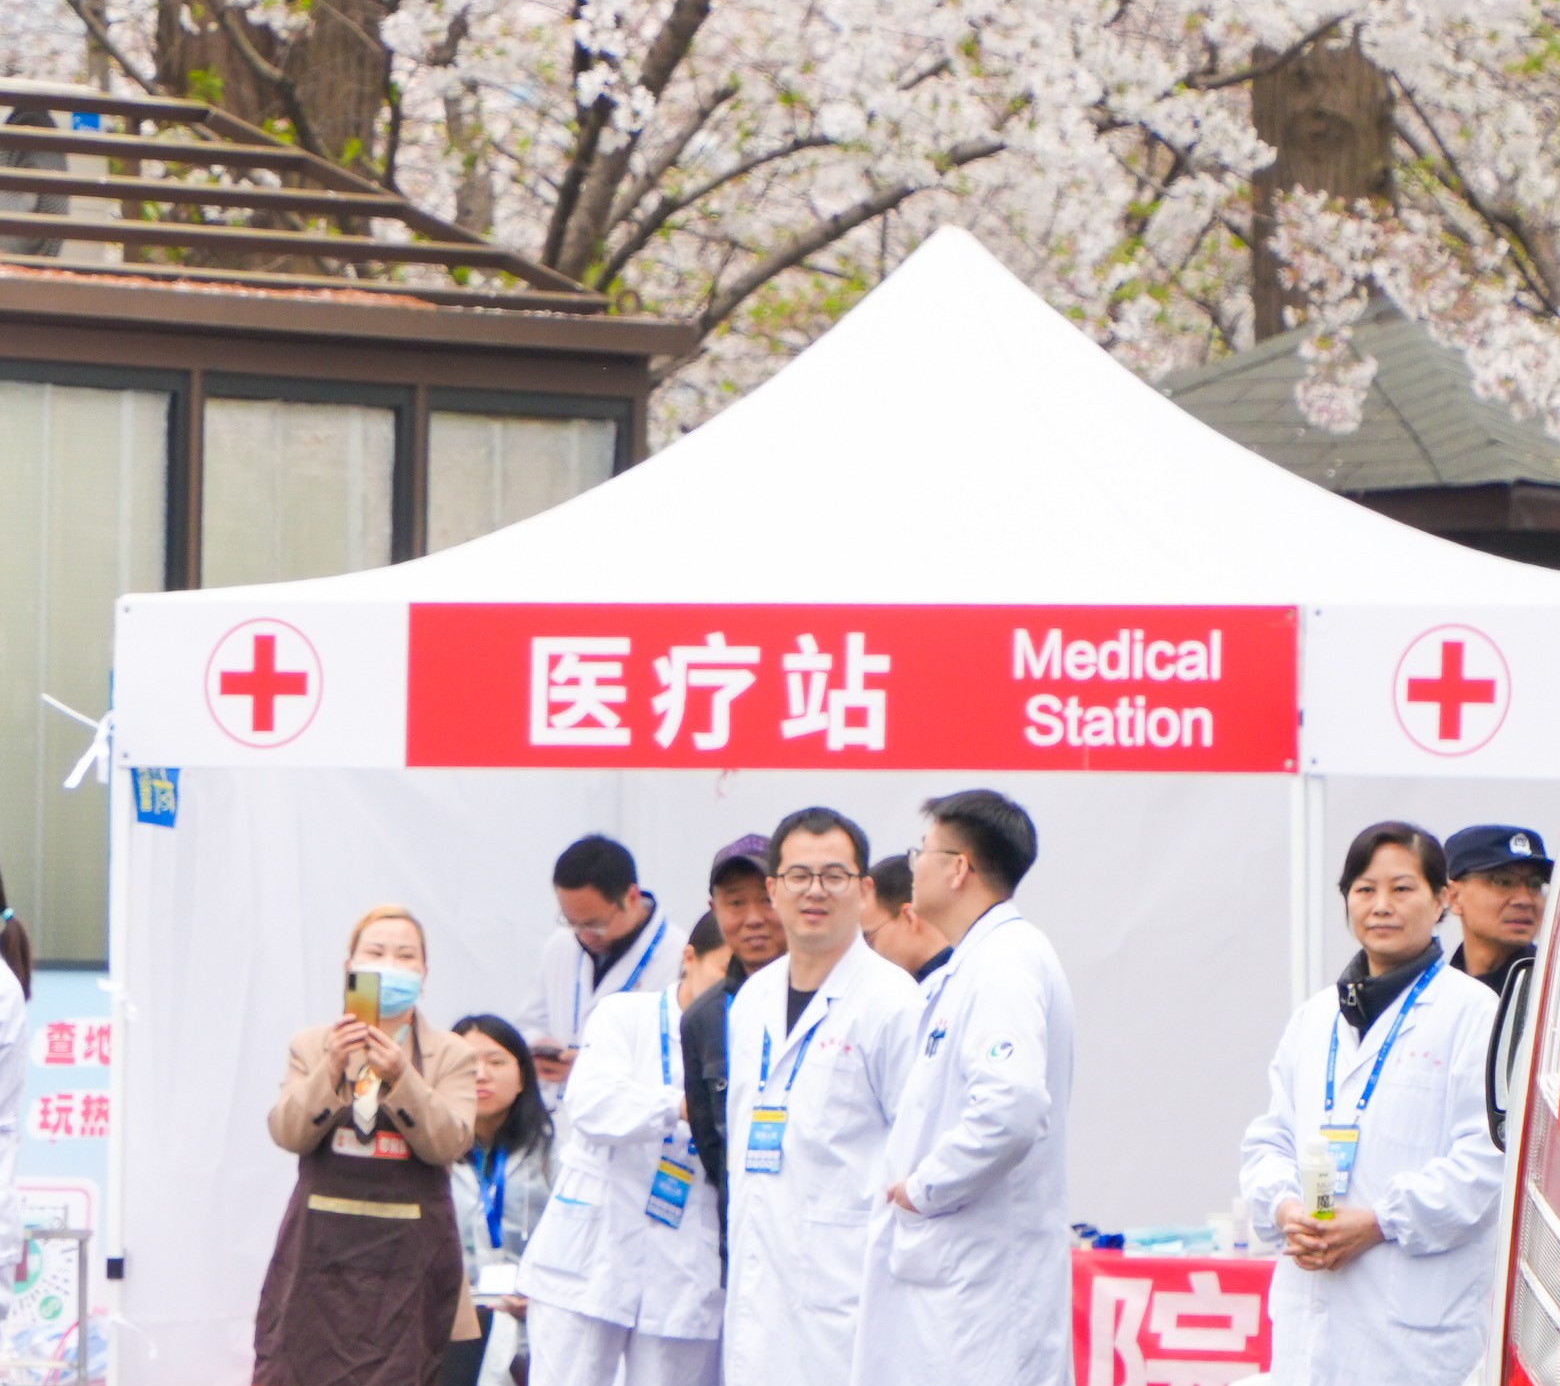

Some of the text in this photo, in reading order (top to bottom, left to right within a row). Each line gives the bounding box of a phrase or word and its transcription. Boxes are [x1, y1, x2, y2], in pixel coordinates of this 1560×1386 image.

[1012, 627, 1223, 682] Medical
[529, 630, 892, 752] 医疗站
[1024, 693, 1213, 748] Station
